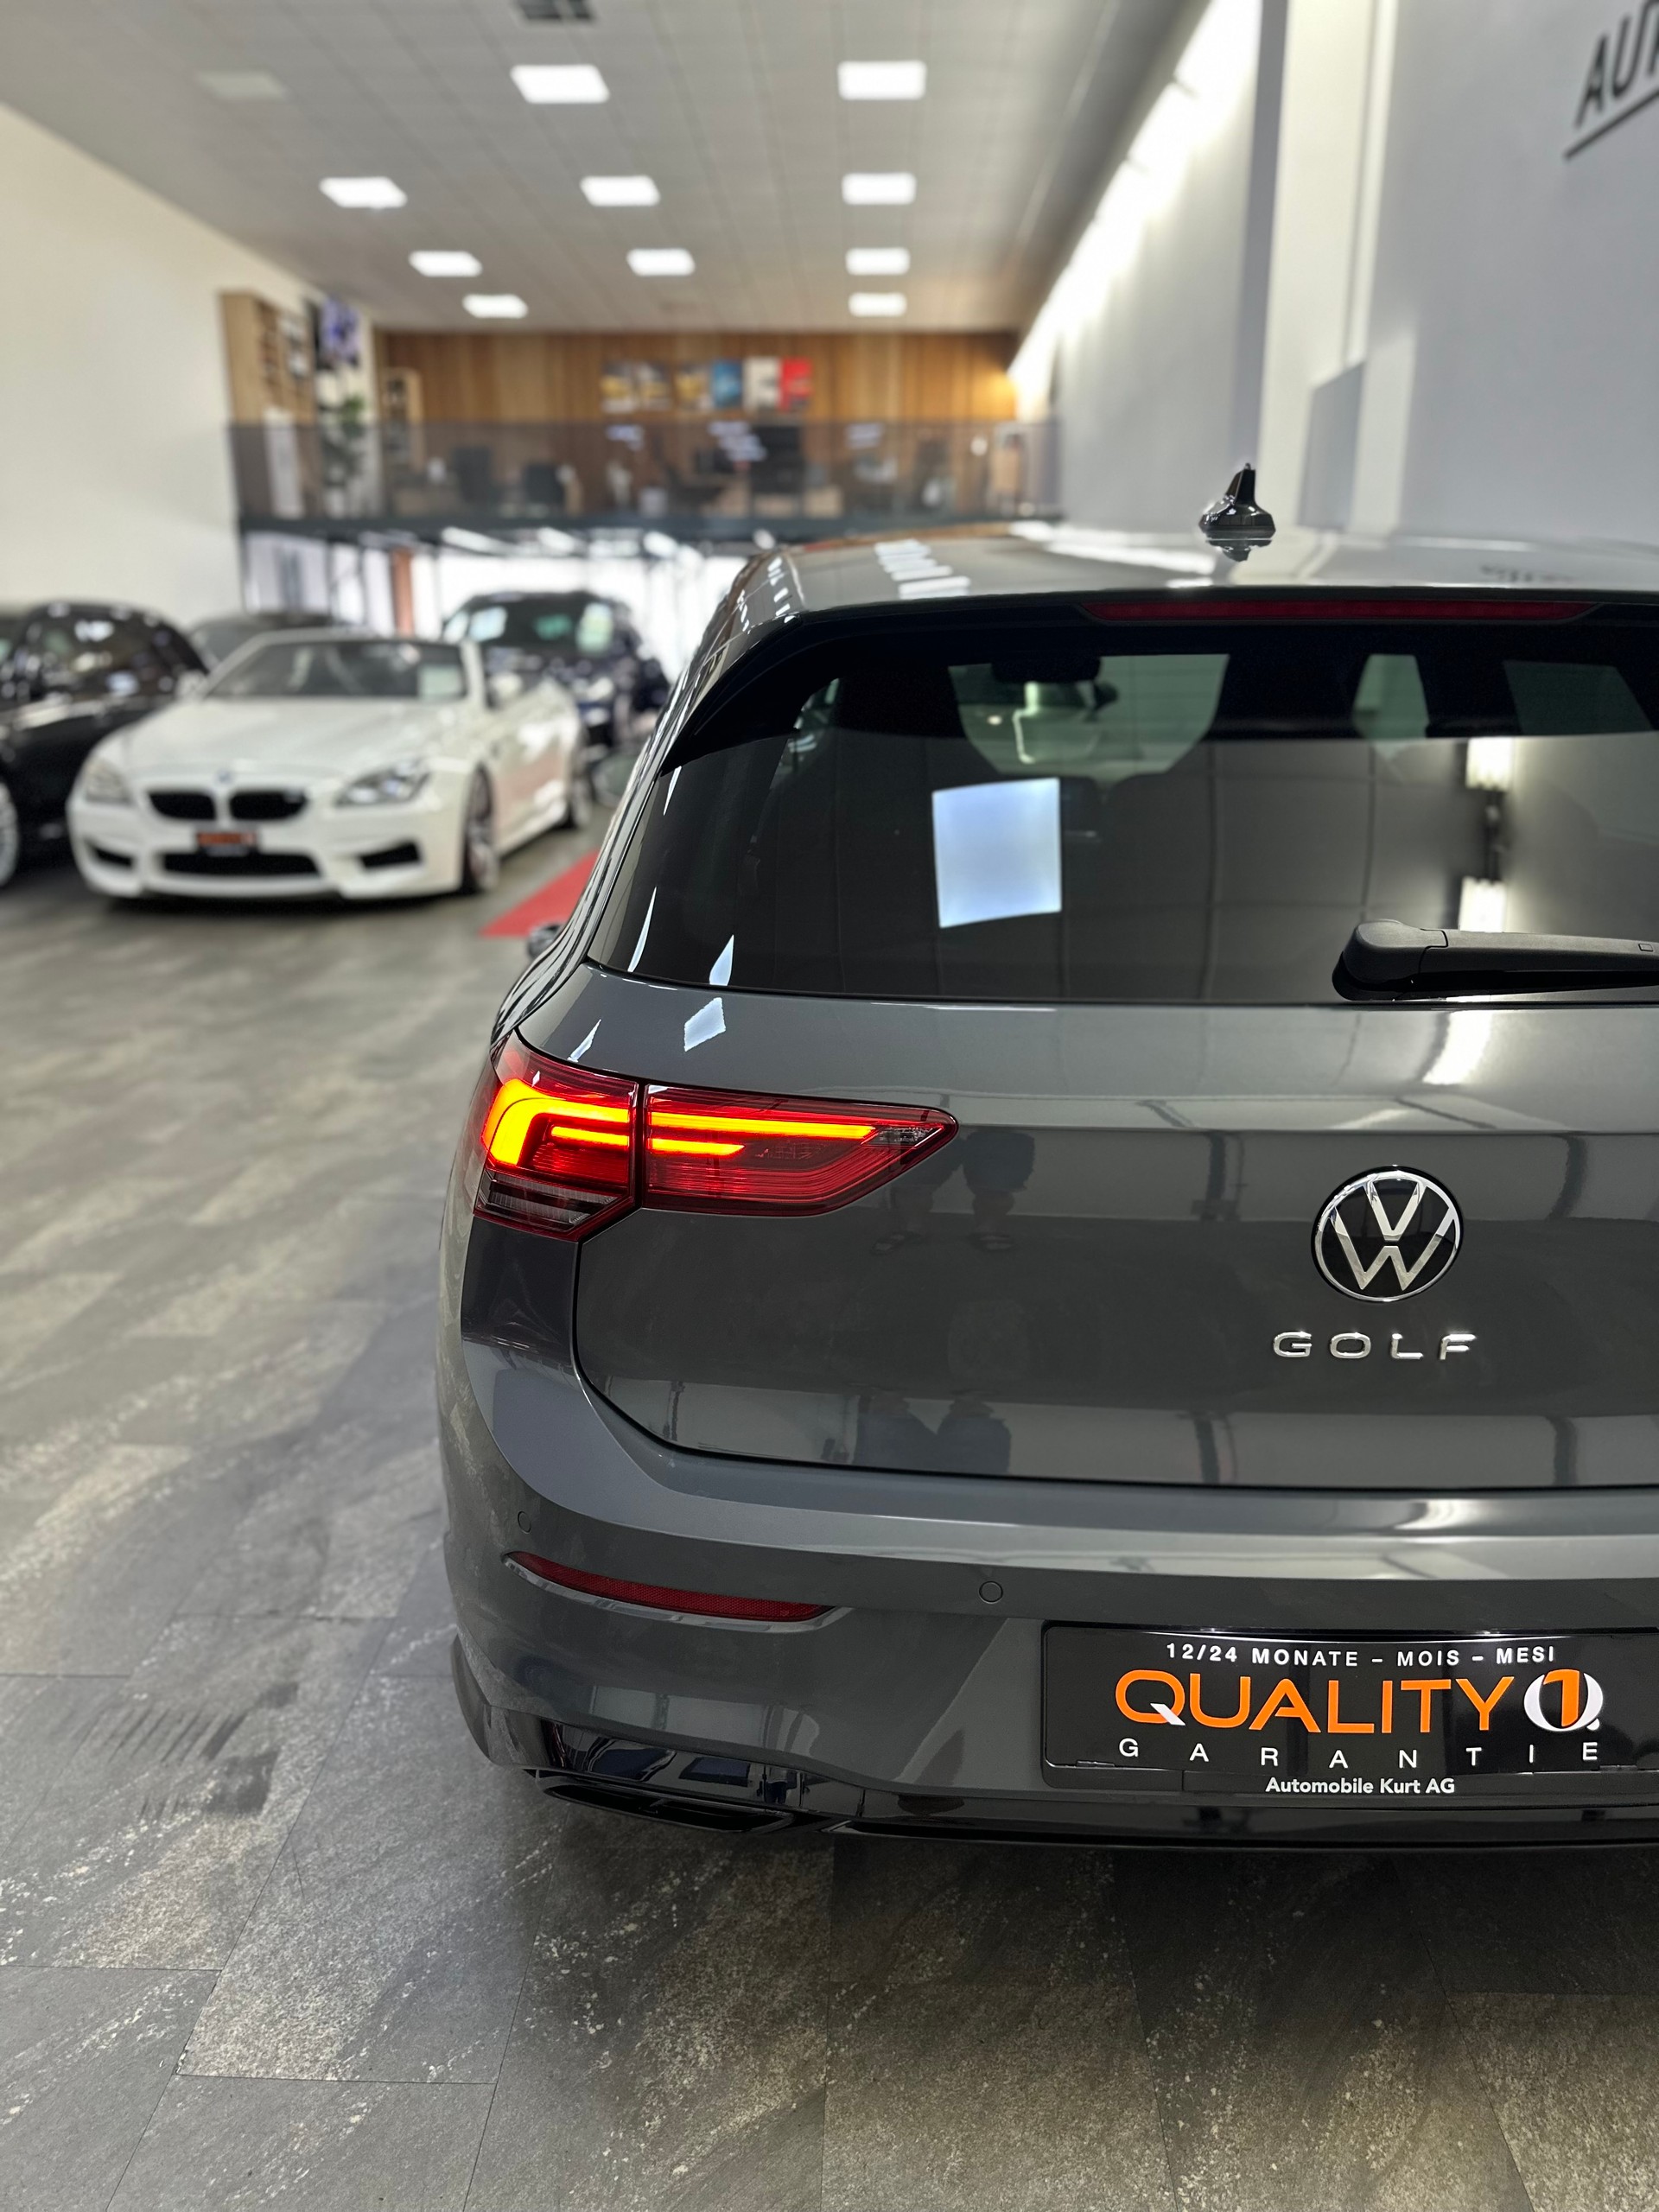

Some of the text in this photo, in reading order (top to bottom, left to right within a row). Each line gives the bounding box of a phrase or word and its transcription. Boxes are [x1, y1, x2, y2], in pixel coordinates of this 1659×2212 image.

[1273, 1332, 1476, 1360] GOLF
[1166, 1643, 1237, 1662] 12/24
[1252, 1648, 1358, 1667] MONATE
[1397, 1649, 1459, 1667] MOIS
[1497, 1645, 1554, 1664] MESI
[1115, 1669, 1515, 1733] QUALITY
[1118, 1738, 1598, 1769] GARANTIE
[1265, 1777, 1455, 1794] Automobile Kurt AG
